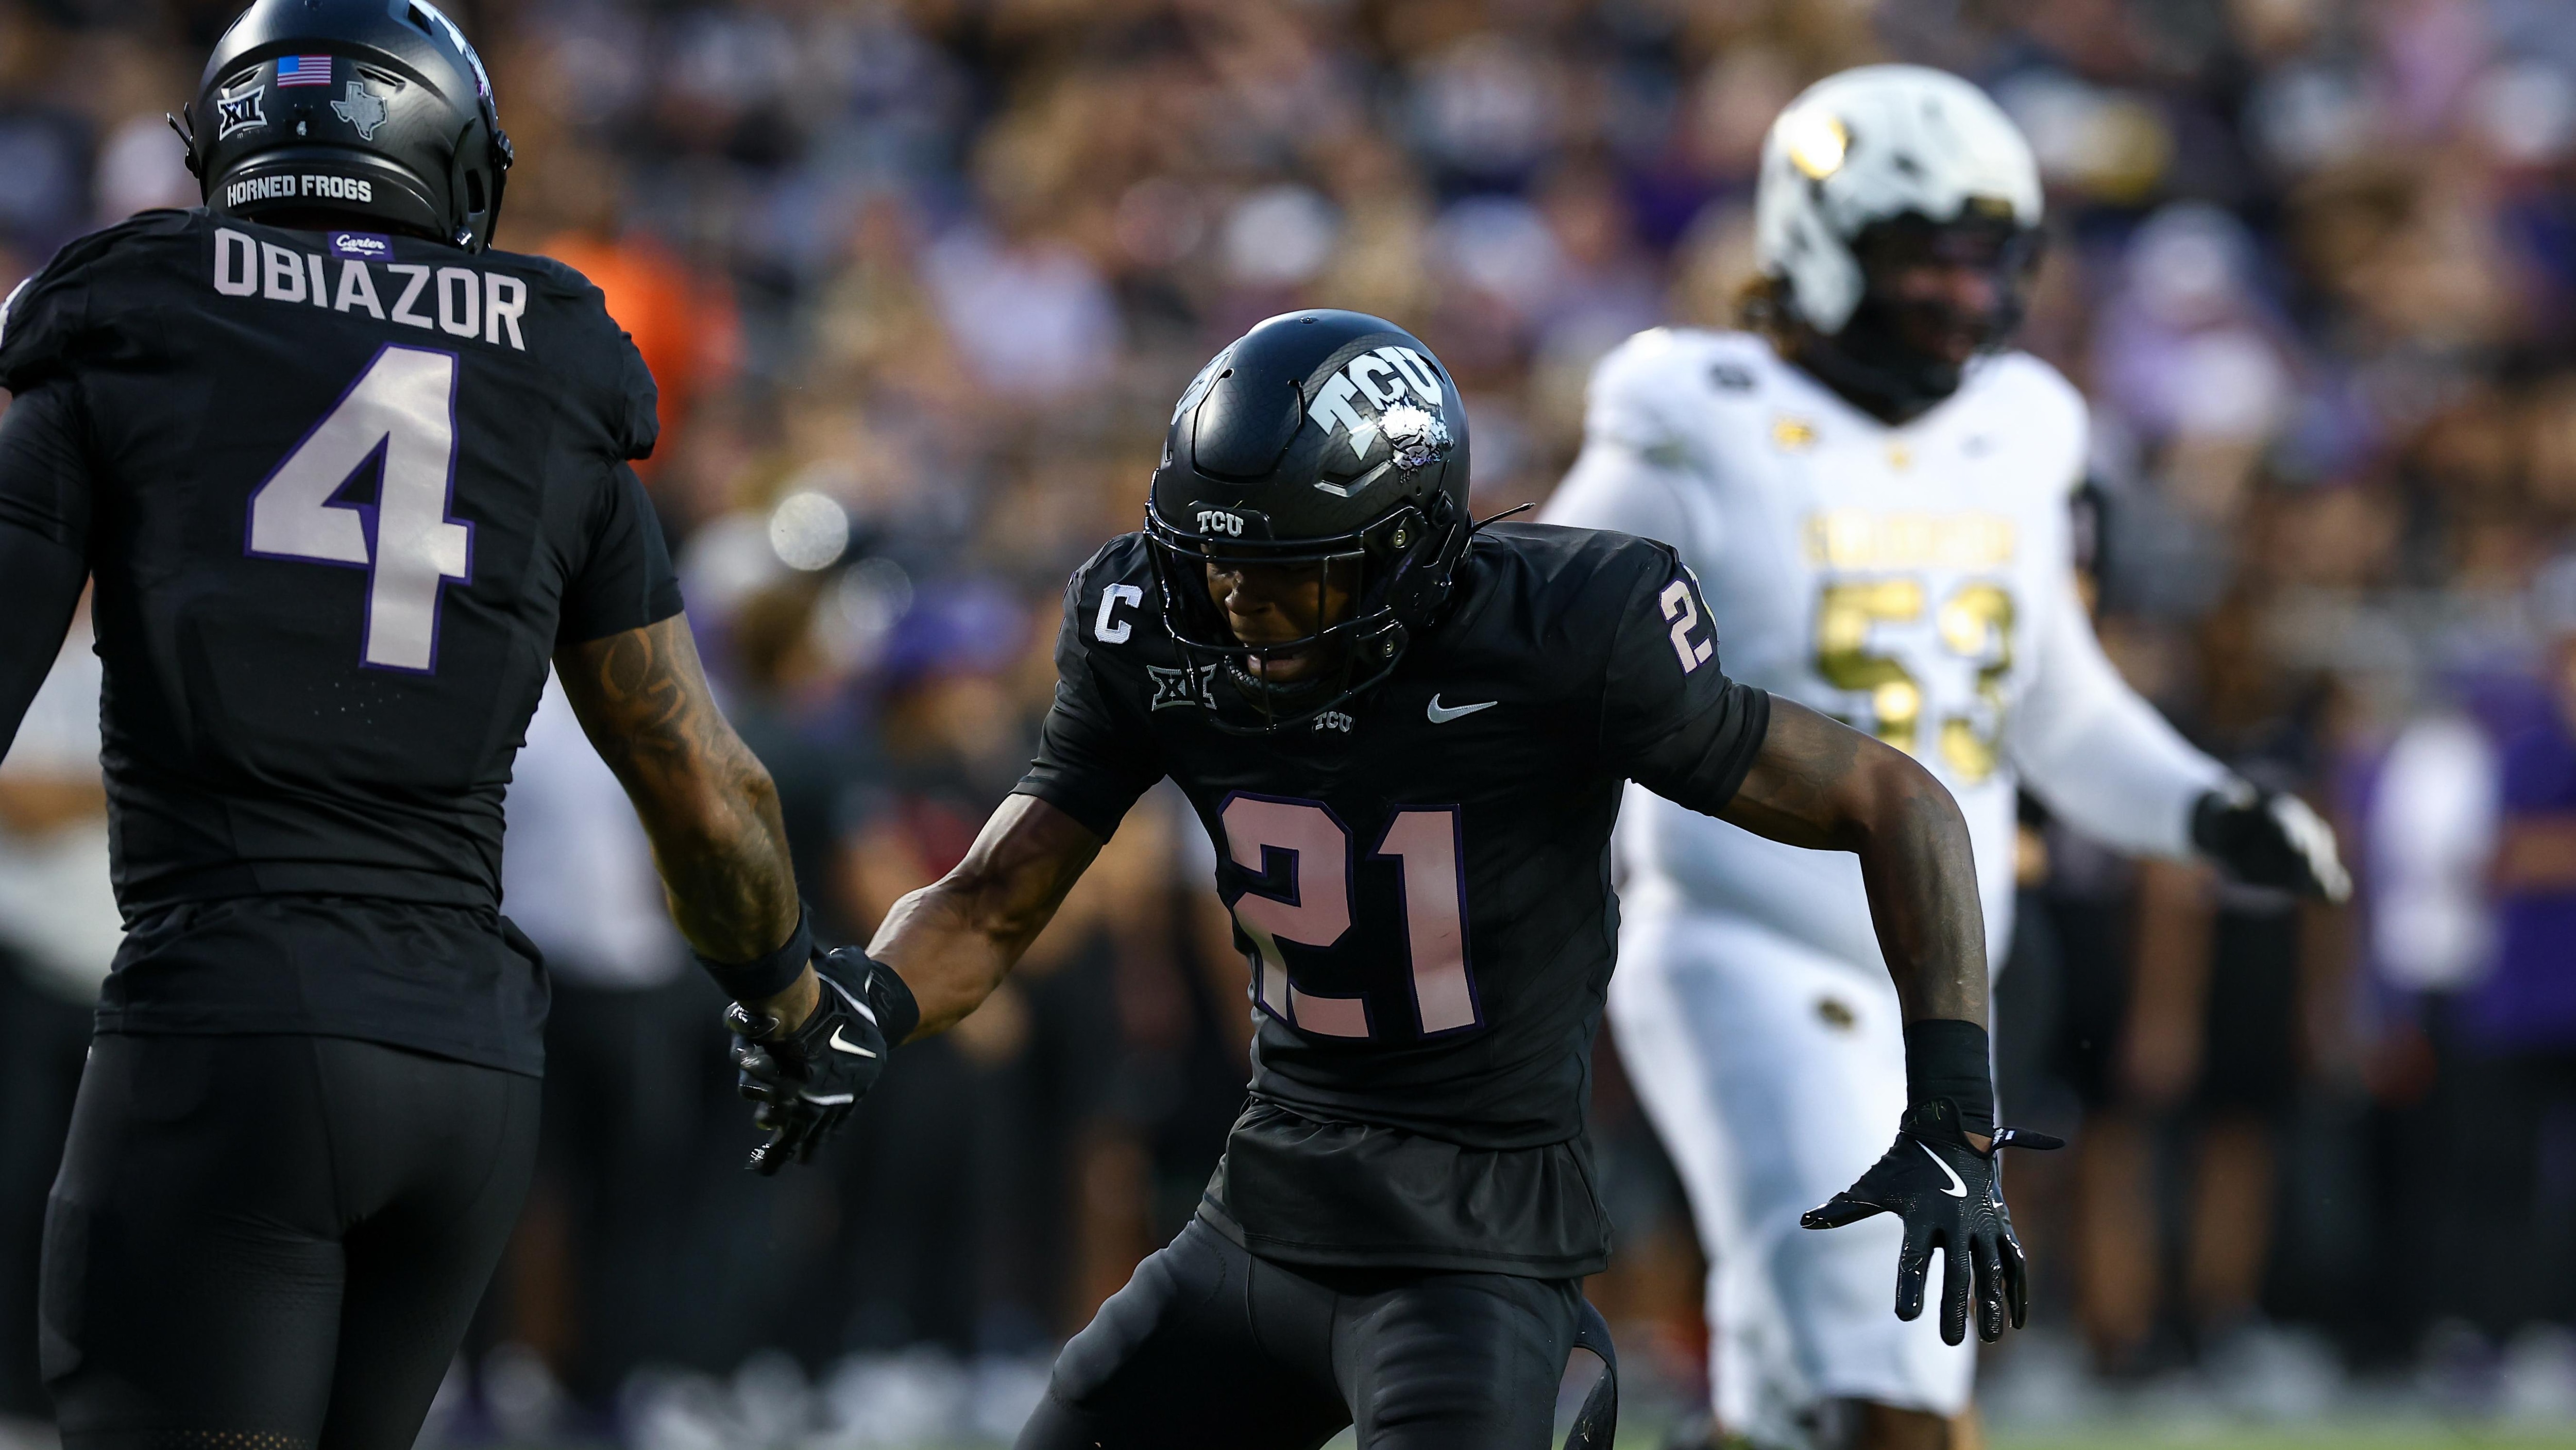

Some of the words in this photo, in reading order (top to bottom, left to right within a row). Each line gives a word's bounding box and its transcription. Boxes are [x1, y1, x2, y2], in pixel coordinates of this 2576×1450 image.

[227, 175, 296, 208] HORNED
[301, 175, 372, 203] FROGS
[336, 234, 386, 250] Carter
[214, 227, 527, 351] OBIAZOR
[1308, 346, 1444, 461] TCU
[243, 342, 475, 676] 4
[1197, 510, 1244, 537] TCU
[1094, 582, 1143, 644] C
[1658, 562, 1717, 676] 2
[1312, 711, 1353, 733] TCU
[1216, 789, 1484, 1041] 21
